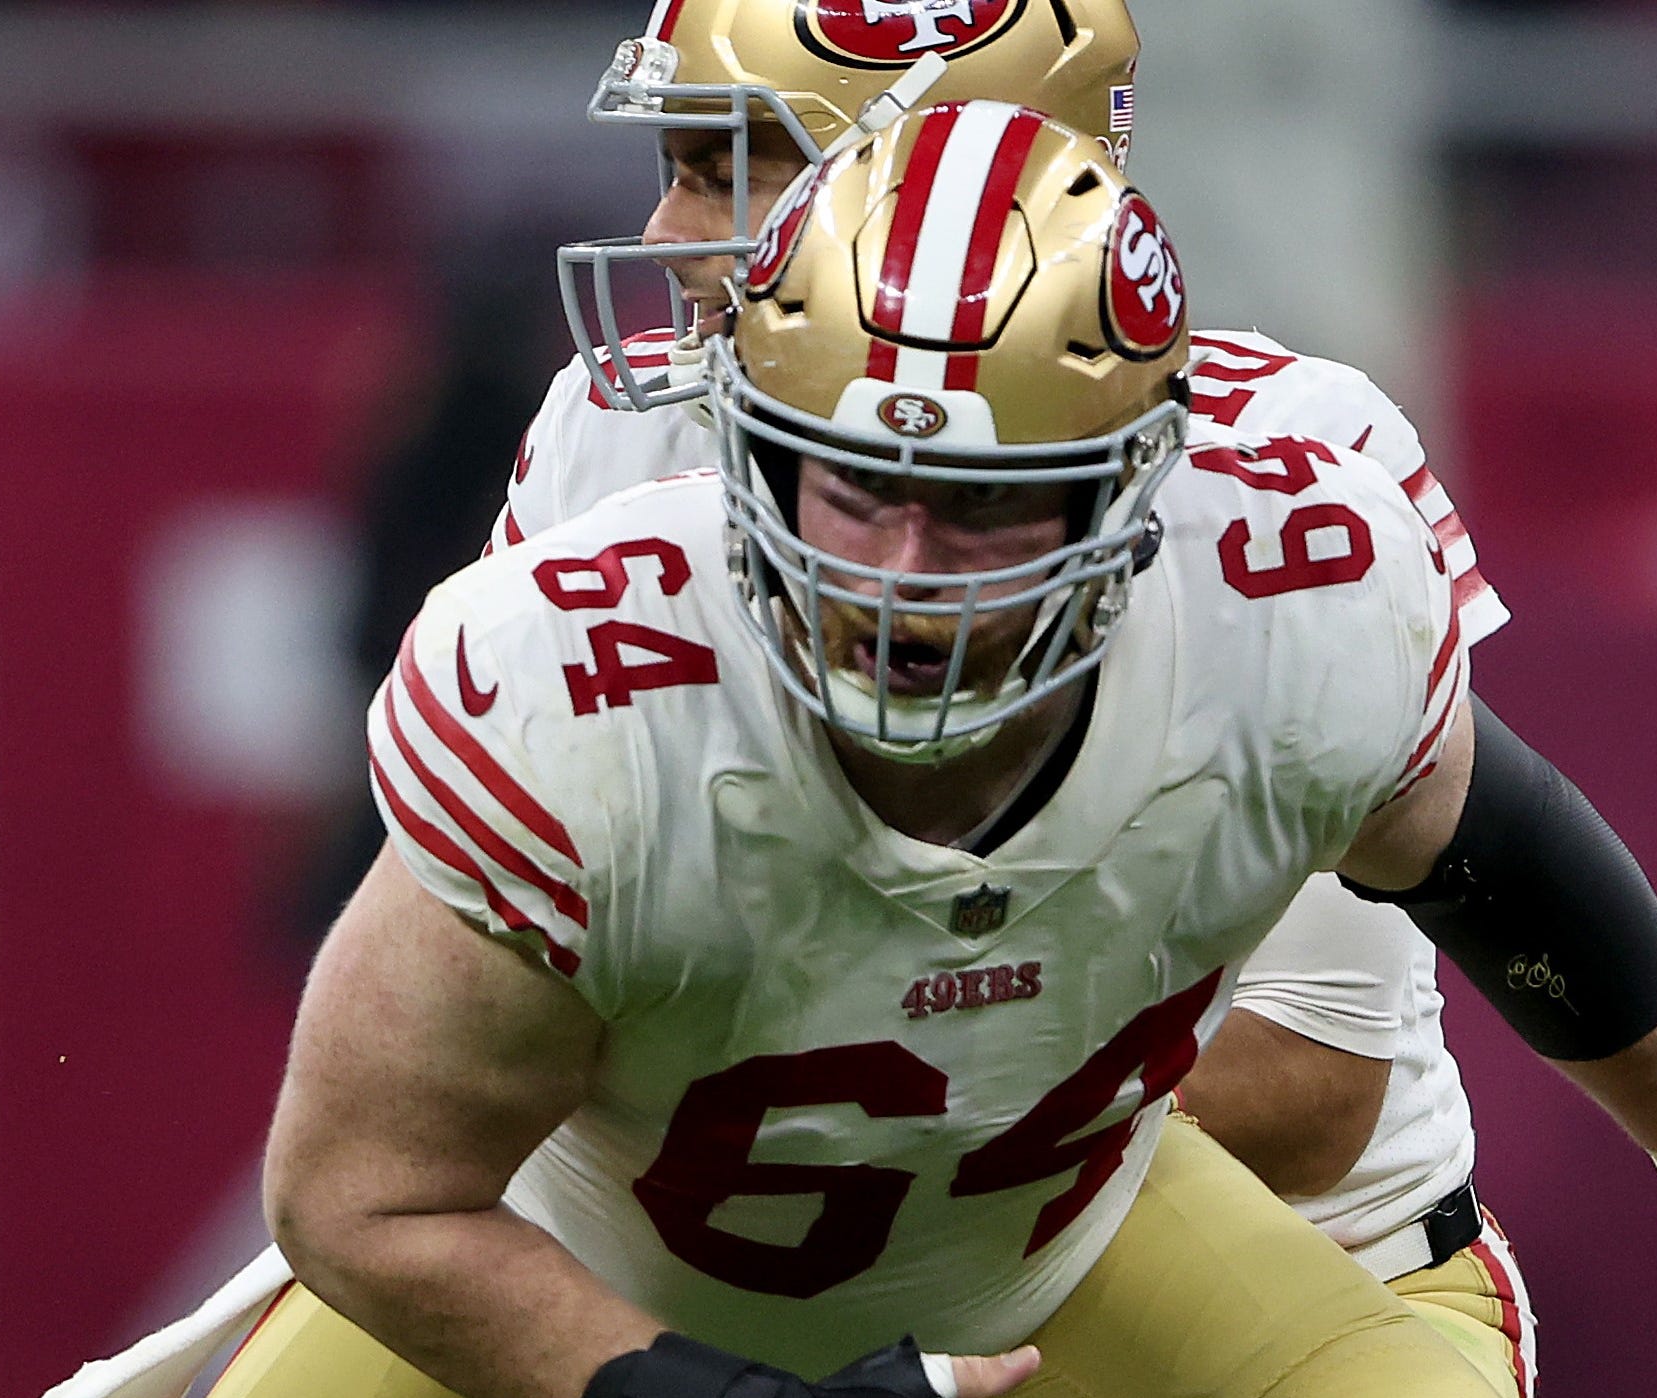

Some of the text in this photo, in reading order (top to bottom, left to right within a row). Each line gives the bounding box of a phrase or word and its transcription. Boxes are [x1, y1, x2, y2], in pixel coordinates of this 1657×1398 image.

[1187, 434, 1377, 600] 64
[532, 536, 719, 717] 64
[900, 961, 1042, 1019] 49ERS
[633, 966, 1224, 1299] 64
